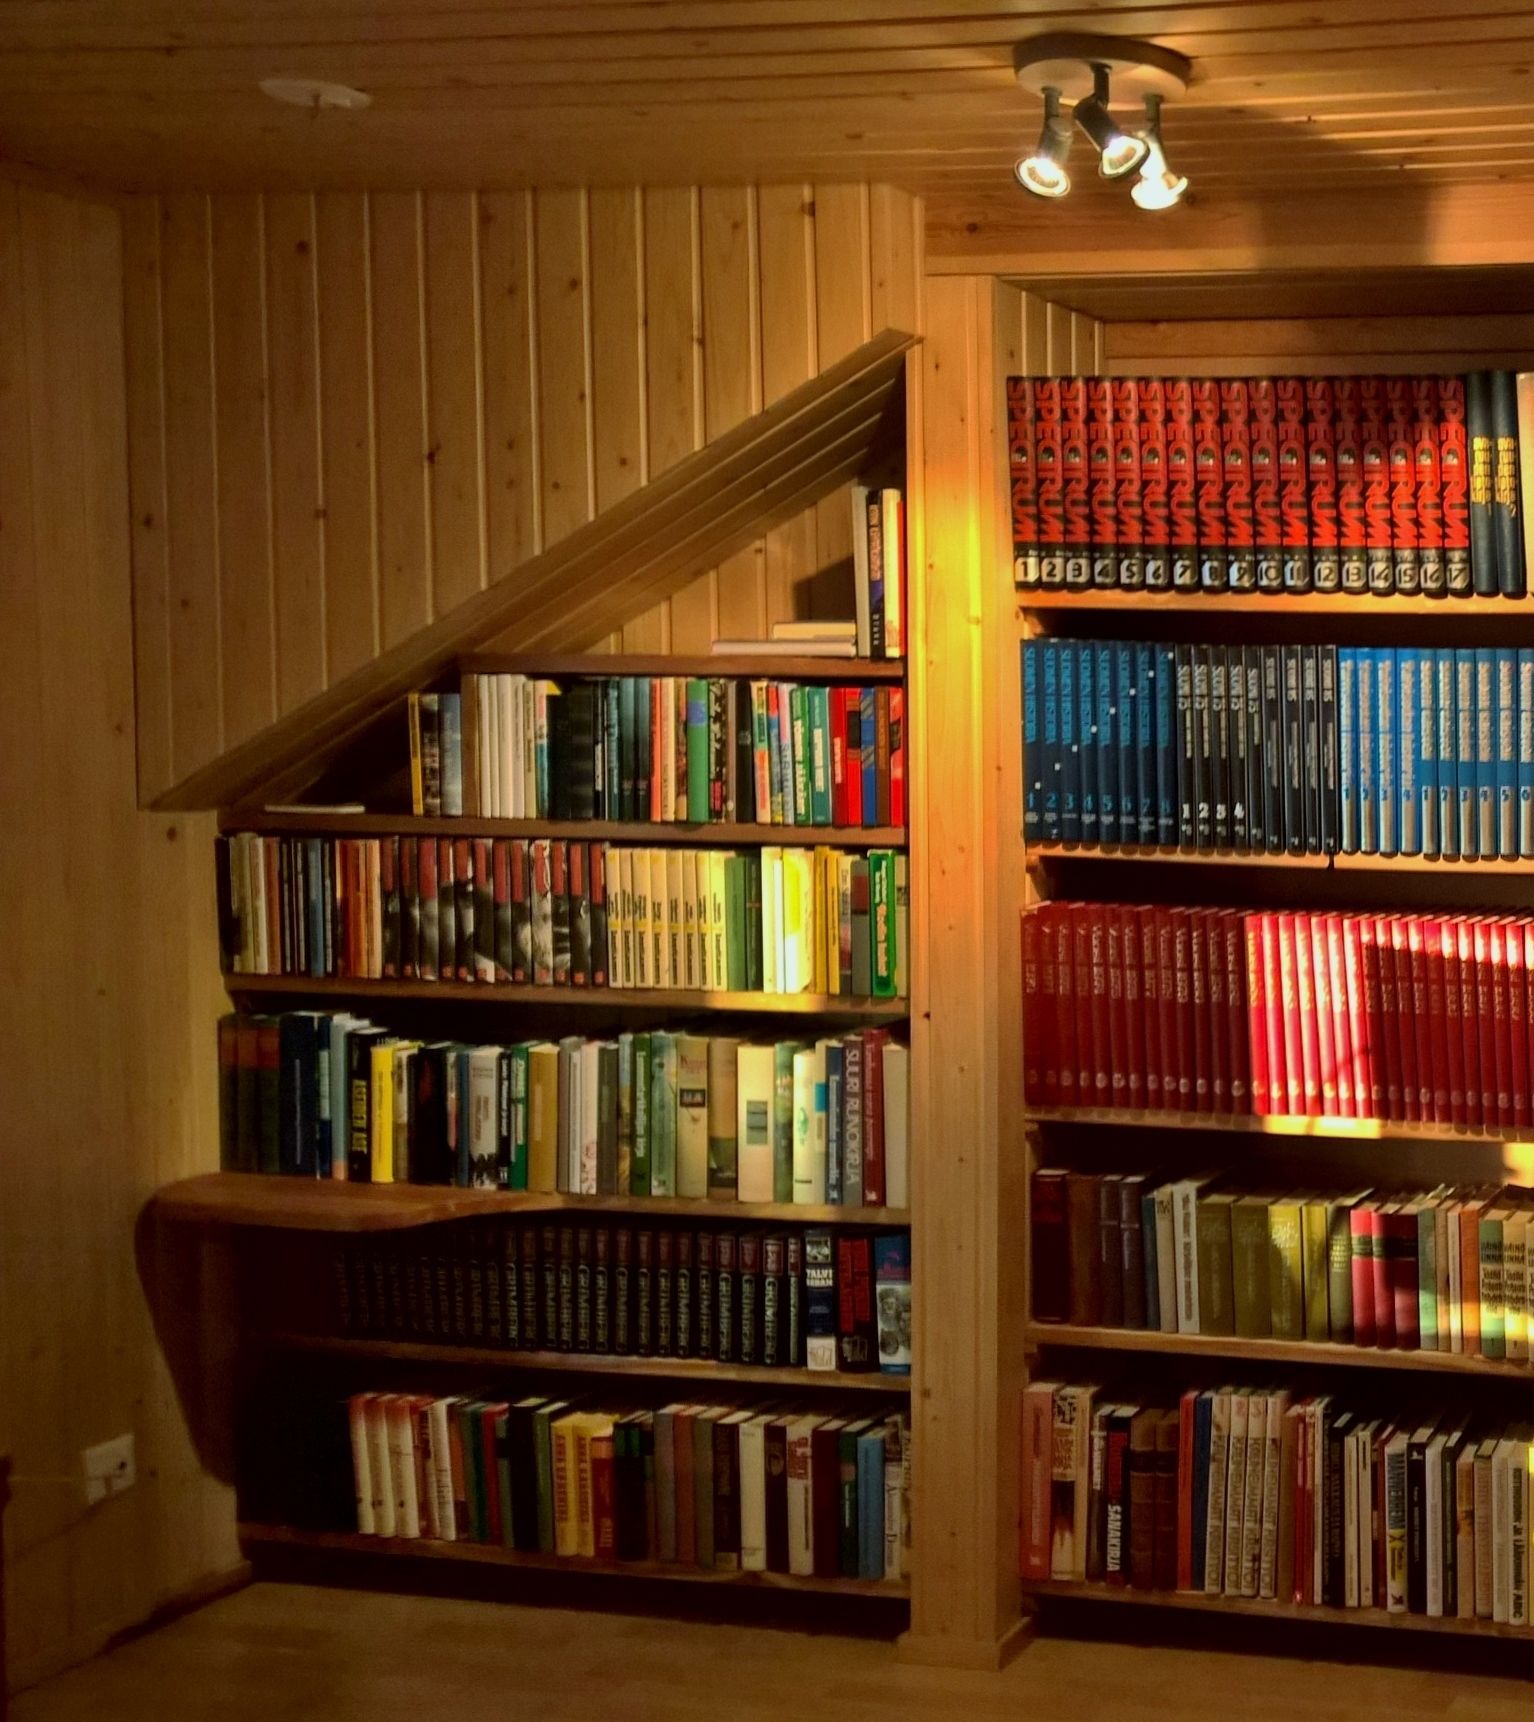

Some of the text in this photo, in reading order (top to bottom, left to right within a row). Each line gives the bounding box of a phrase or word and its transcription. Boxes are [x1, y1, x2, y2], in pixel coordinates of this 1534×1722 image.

[1008, 380, 1038, 543] SPECTRUM
[1036, 380, 1064, 543] SPECTRUM
[1062, 380, 1090, 543] SPECTRUM
[1089, 380, 1117, 543] SPECTRUM
[1113, 380, 1143, 543] SPECTRUM
[1138, 380, 1169, 543] SPECTRUM
[1165, 380, 1196, 543] SPECTRUM
[1193, 380, 1225, 545] SPECTRUM
[1221, 380, 1254, 545] SPECTRUM
[1250, 380, 1281, 545] SPECTRUM
[1277, 380, 1308, 545] SPECTRUM
[1306, 380, 1337, 545] SPECTRUM
[1335, 380, 1365, 545] SPECTRUM
[1361, 380, 1392, 547] SPECTRUM
[1387, 380, 1418, 547] SPECTRUM
[1413, 380, 1443, 547] SPECTRUM
[1439, 380, 1469, 547] SPECTRUM
[1182, 804, 1190, 819] 1
[1199, 803, 1209, 818] 2
[1216, 804, 1226, 819] 3
[1234, 802, 1244, 819] 4
[846, 1049, 860, 1184] SUURI RUNOKIRJA
[806, 1269, 833, 1278] TALVI
[1107, 1504, 1121, 1571] SANAKIRJA
